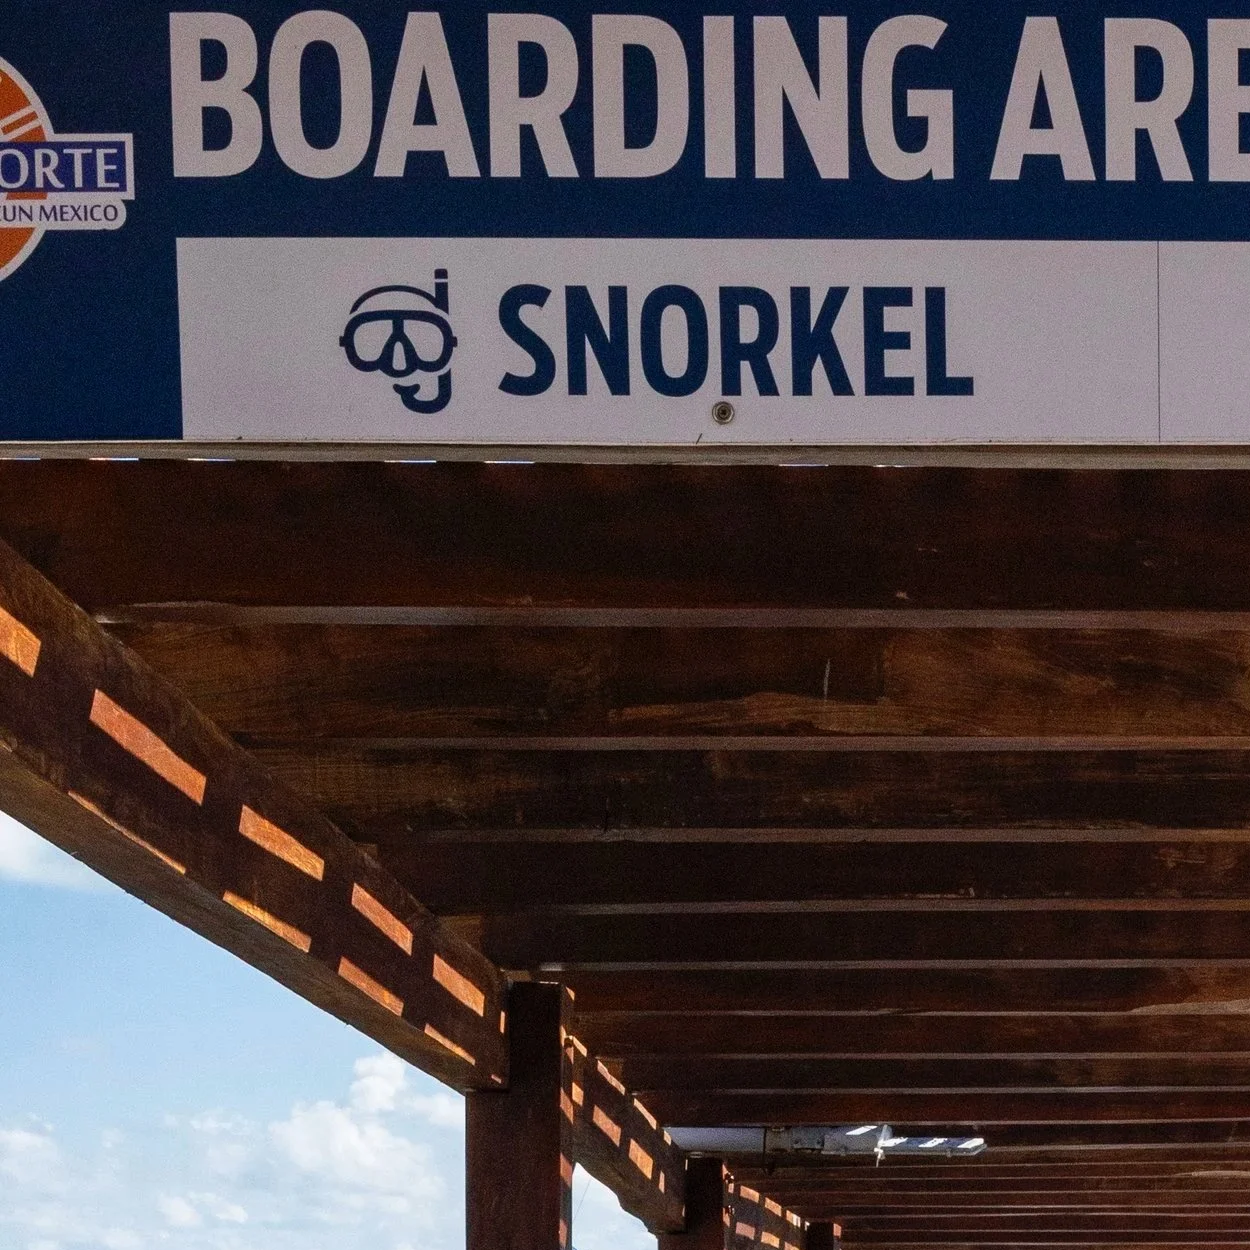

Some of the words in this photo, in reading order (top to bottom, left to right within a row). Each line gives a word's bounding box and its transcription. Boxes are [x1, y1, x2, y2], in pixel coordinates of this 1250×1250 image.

[170, 10, 955, 181] BOARDING
[0, 149, 120, 189] ORTE
[0, 204, 34, 222] UN
[39, 204, 119, 222] MEXICO
[499, 284, 974, 397] SNORKEL
